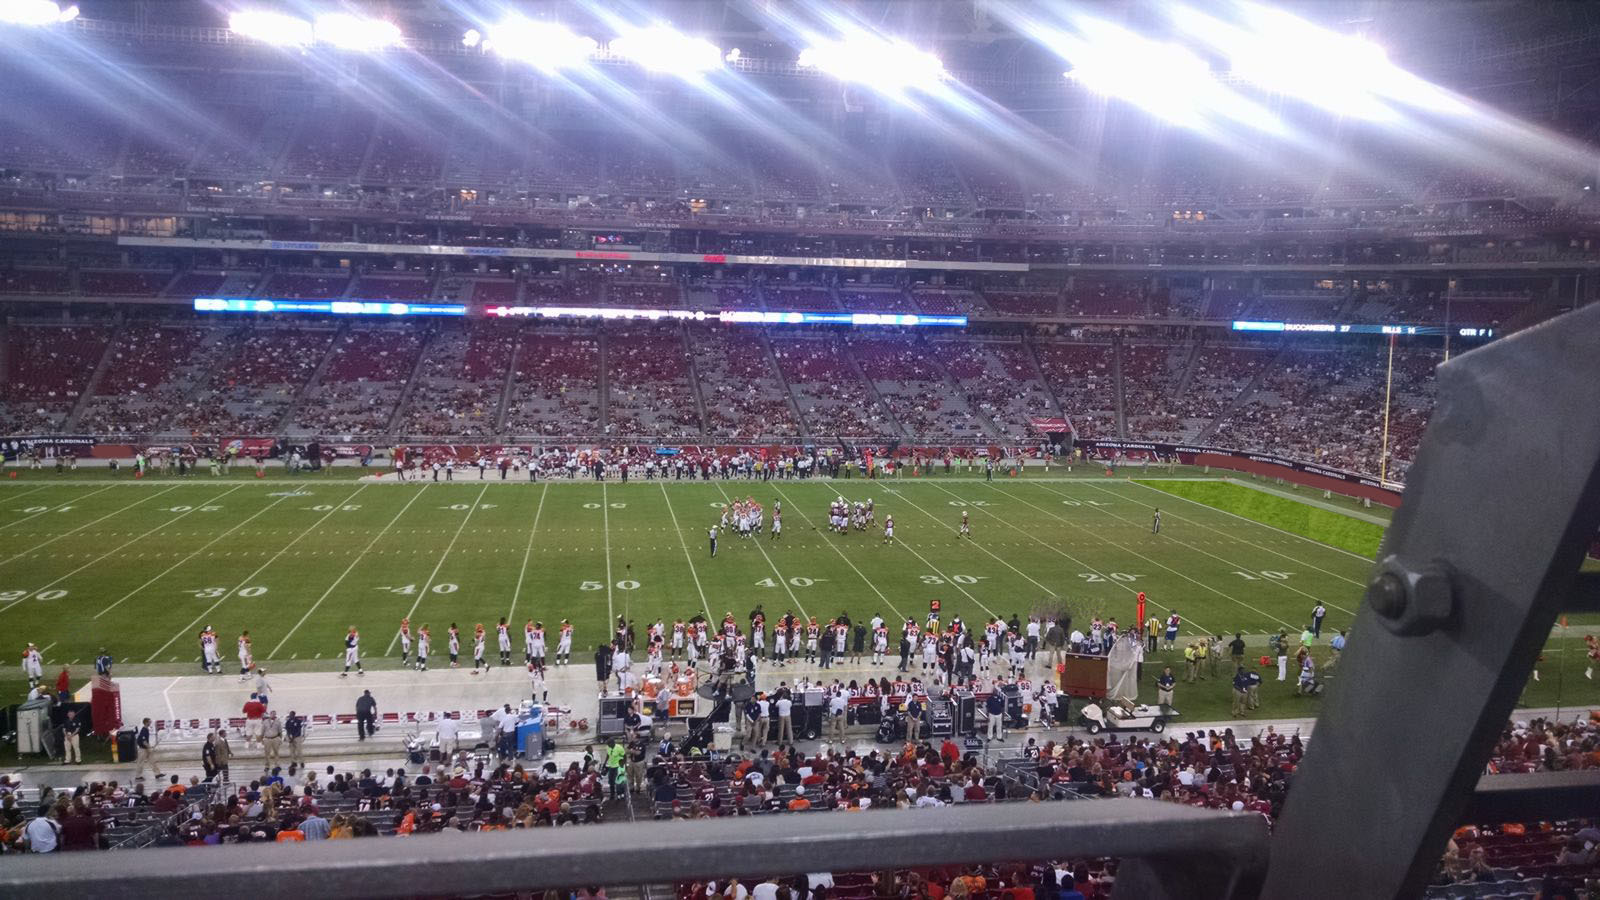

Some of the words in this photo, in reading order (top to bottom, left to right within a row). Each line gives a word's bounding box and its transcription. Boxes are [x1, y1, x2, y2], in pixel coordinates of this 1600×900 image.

[1285, 323, 1336, 332] BUCCANEERS
[1340, 324, 1351, 333] 27
[1459, 328, 1477, 336] QTR
[1249, 455, 1273, 463] ARIZONA
[1273, 458, 1293, 467] CARDINALS
[1304, 466, 1323, 475] ARIZONA
[1321, 468, 1346, 480] CARDINALS
[1359, 479, 1380, 488] ARIZONA
[931, 600, 940, 609] 2
[928, 637, 936, 645] 73
[851, 689, 859, 697] 51
[896, 684, 906, 693] 76
[1030, 749, 1038, 758] 21
[705, 793, 714, 801] 21
[128, 798, 136, 808] 11
